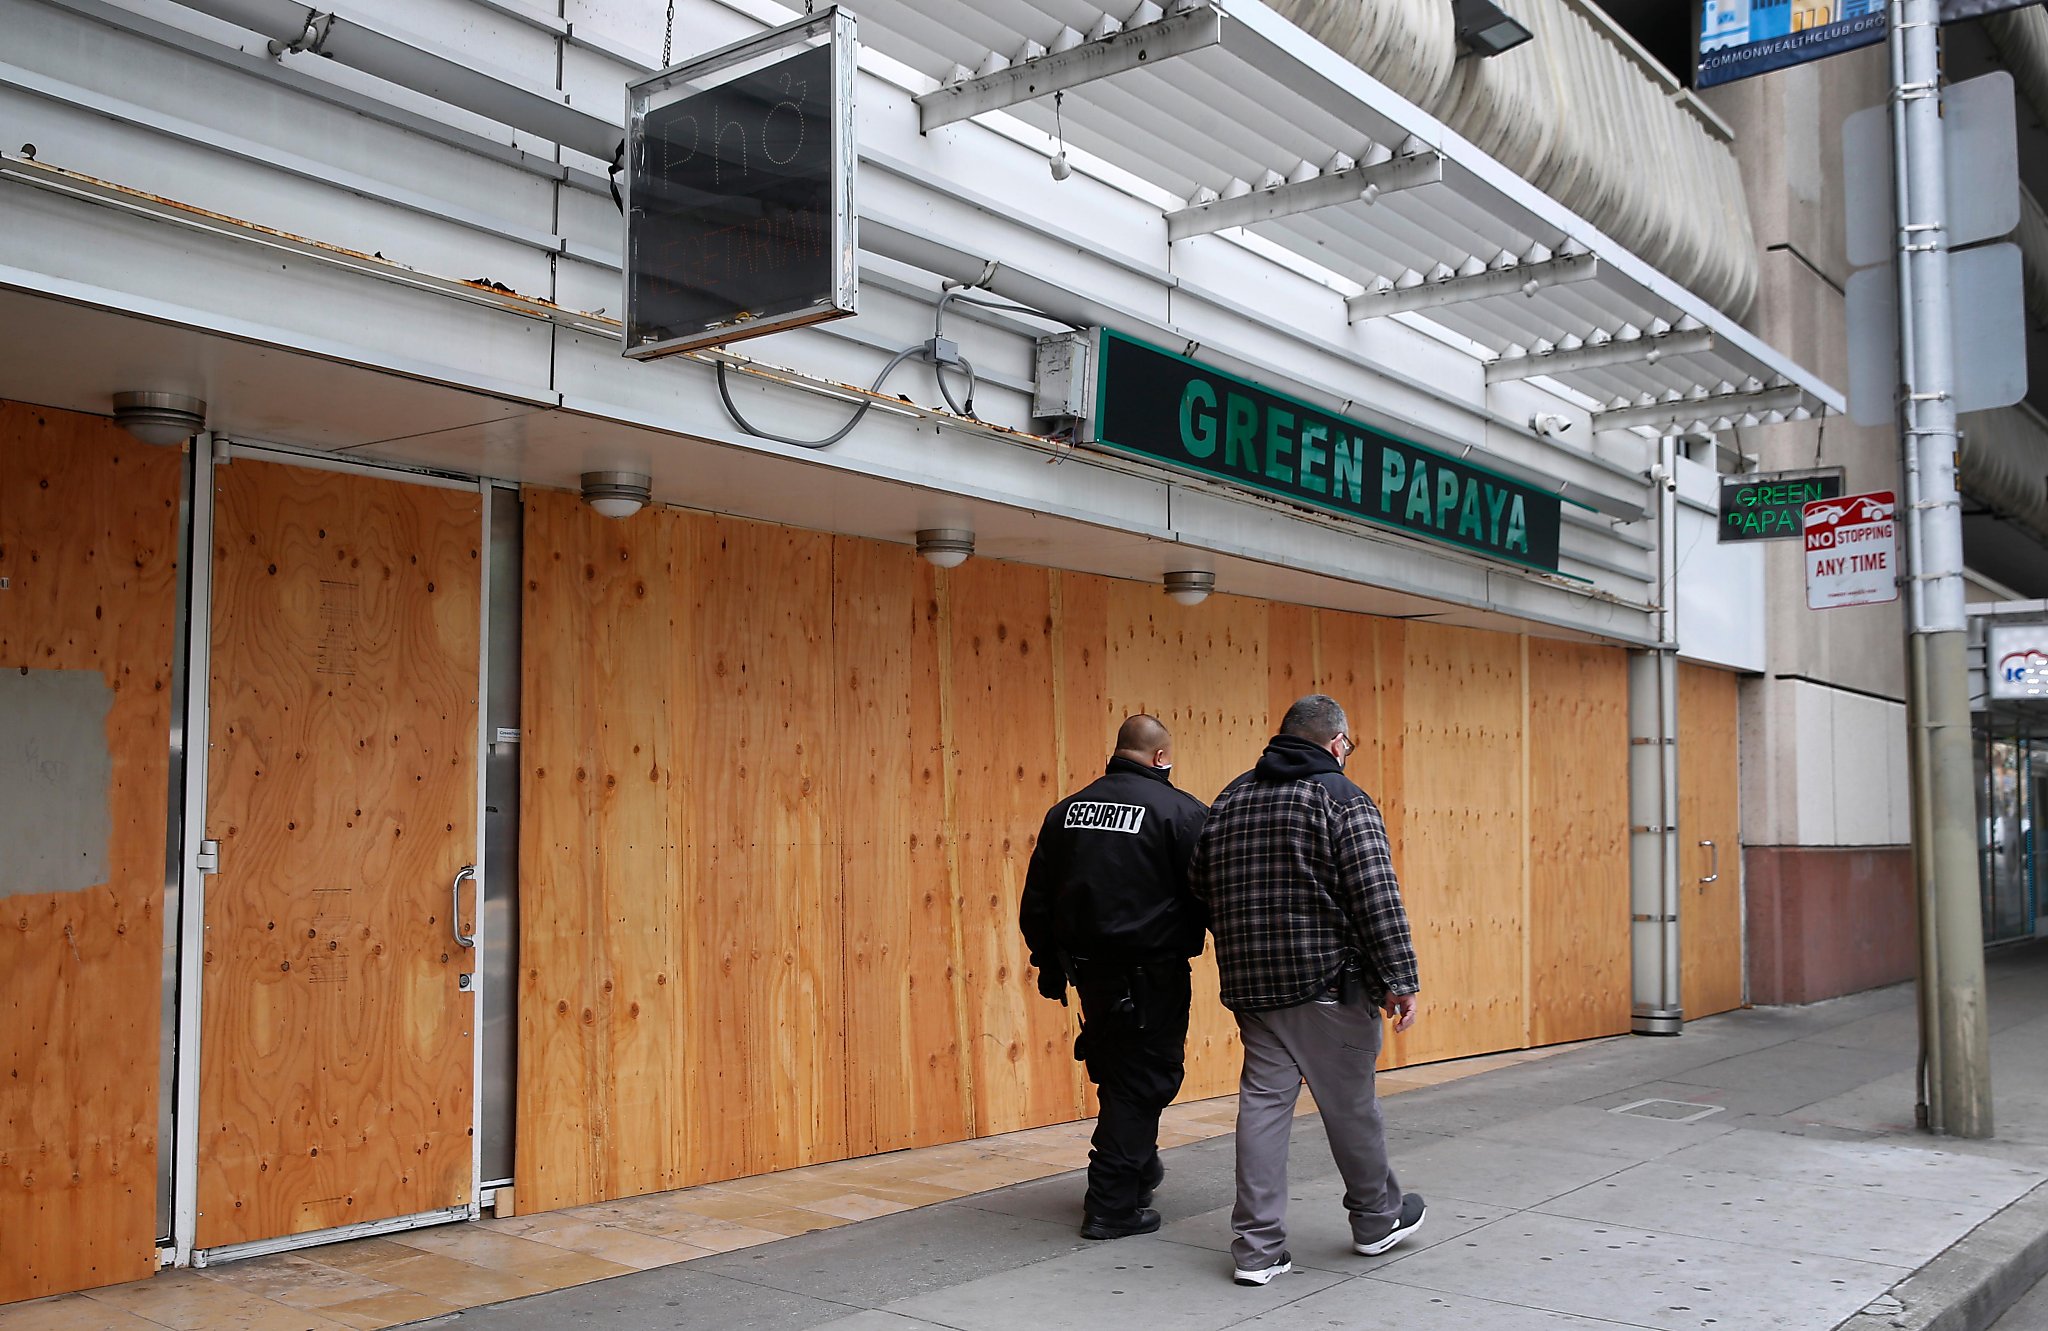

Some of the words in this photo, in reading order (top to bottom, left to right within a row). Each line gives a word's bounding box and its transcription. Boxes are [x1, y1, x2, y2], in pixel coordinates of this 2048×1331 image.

[1703, 13, 1886, 71] COMMONWEALTHCLUB.ORG
[1179, 378, 1363, 504] GREEN
[1380, 446, 1529, 554] PAPAYA
[1735, 482, 1822, 507] GREEN
[1807, 531, 1834, 548] NO
[1837, 524, 1892, 545] STOPPING
[1815, 557, 1847, 577] ANY
[1850, 552, 1887, 574] TIME
[1066, 803, 1143, 831] SECURITY
